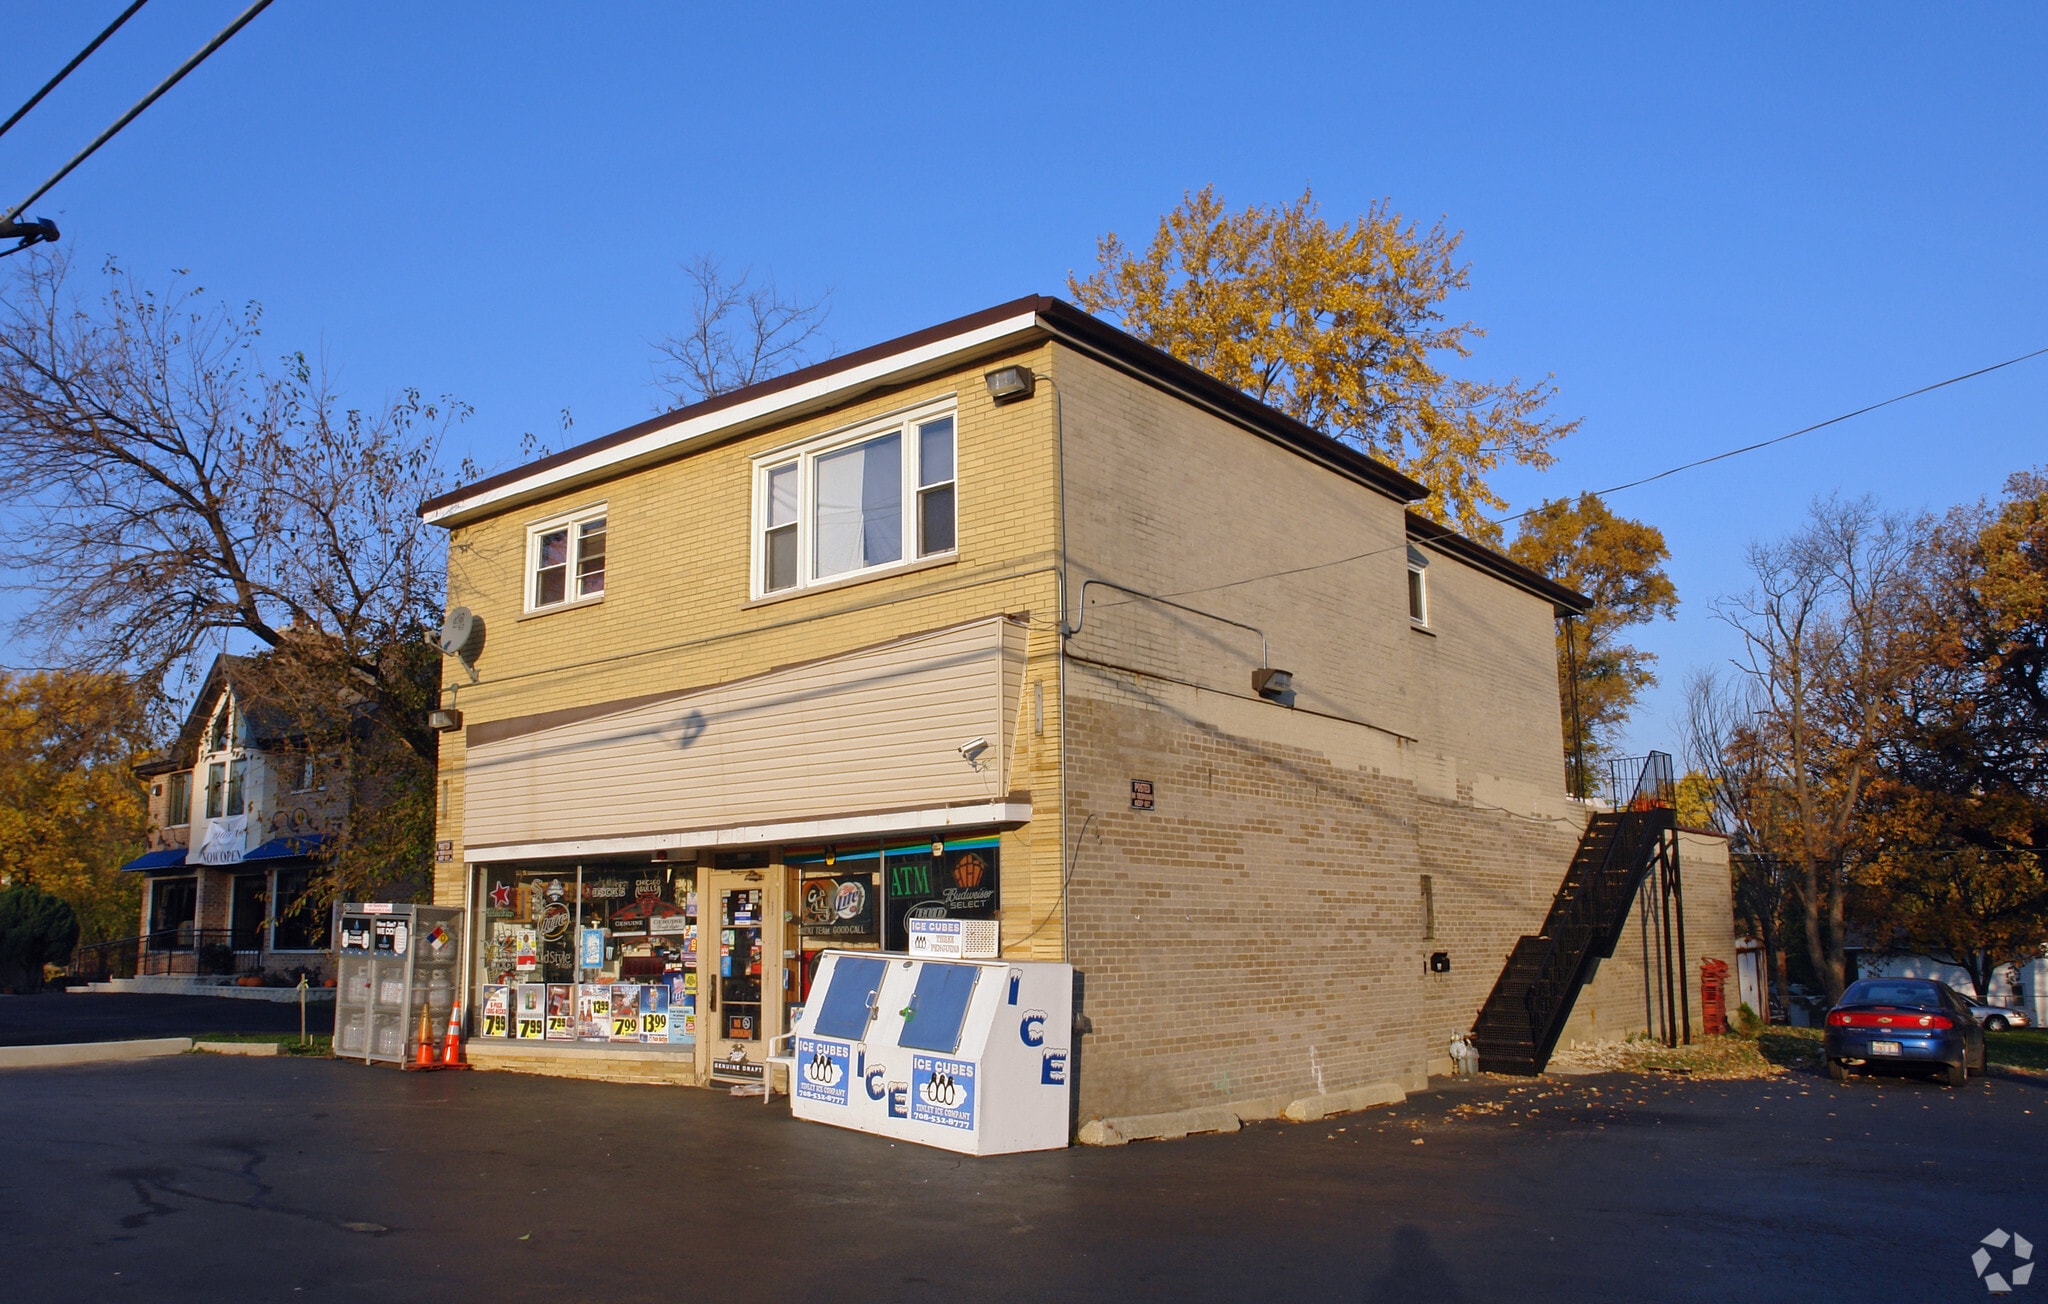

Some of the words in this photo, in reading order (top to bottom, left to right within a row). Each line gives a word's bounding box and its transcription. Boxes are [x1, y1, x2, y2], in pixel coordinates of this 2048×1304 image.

[202, 851, 218, 863] NOW
[220, 850, 241, 862] OPEN
[891, 866, 930, 896] ATM
[943, 888, 994, 902] Budweiser
[950, 900, 987, 909] SELECT
[915, 907, 947, 919] BUD
[832, 926, 849, 934] GOOD
[850, 925, 866, 934] CALL
[912, 921, 926, 931] ICE
[929, 922, 960, 933] CUBES
[936, 935, 955, 943] THREE
[930, 944, 960, 953] PENGUINS
[549, 950, 572, 966] Style
[800, 1040, 814, 1053] ICE
[816, 1043, 849, 1058] CUBES
[714, 1062, 740, 1071] GENUINE
[913, 1057, 932, 1071] ICE
[934, 1061, 973, 1077] CUBES
[823, 1087, 846, 1096] COMPANY
[934, 1107, 944, 1116] ICE
[944, 1109, 971, 1120] COMPANY
[913, 1112, 970, 1129] 708-532-8777
